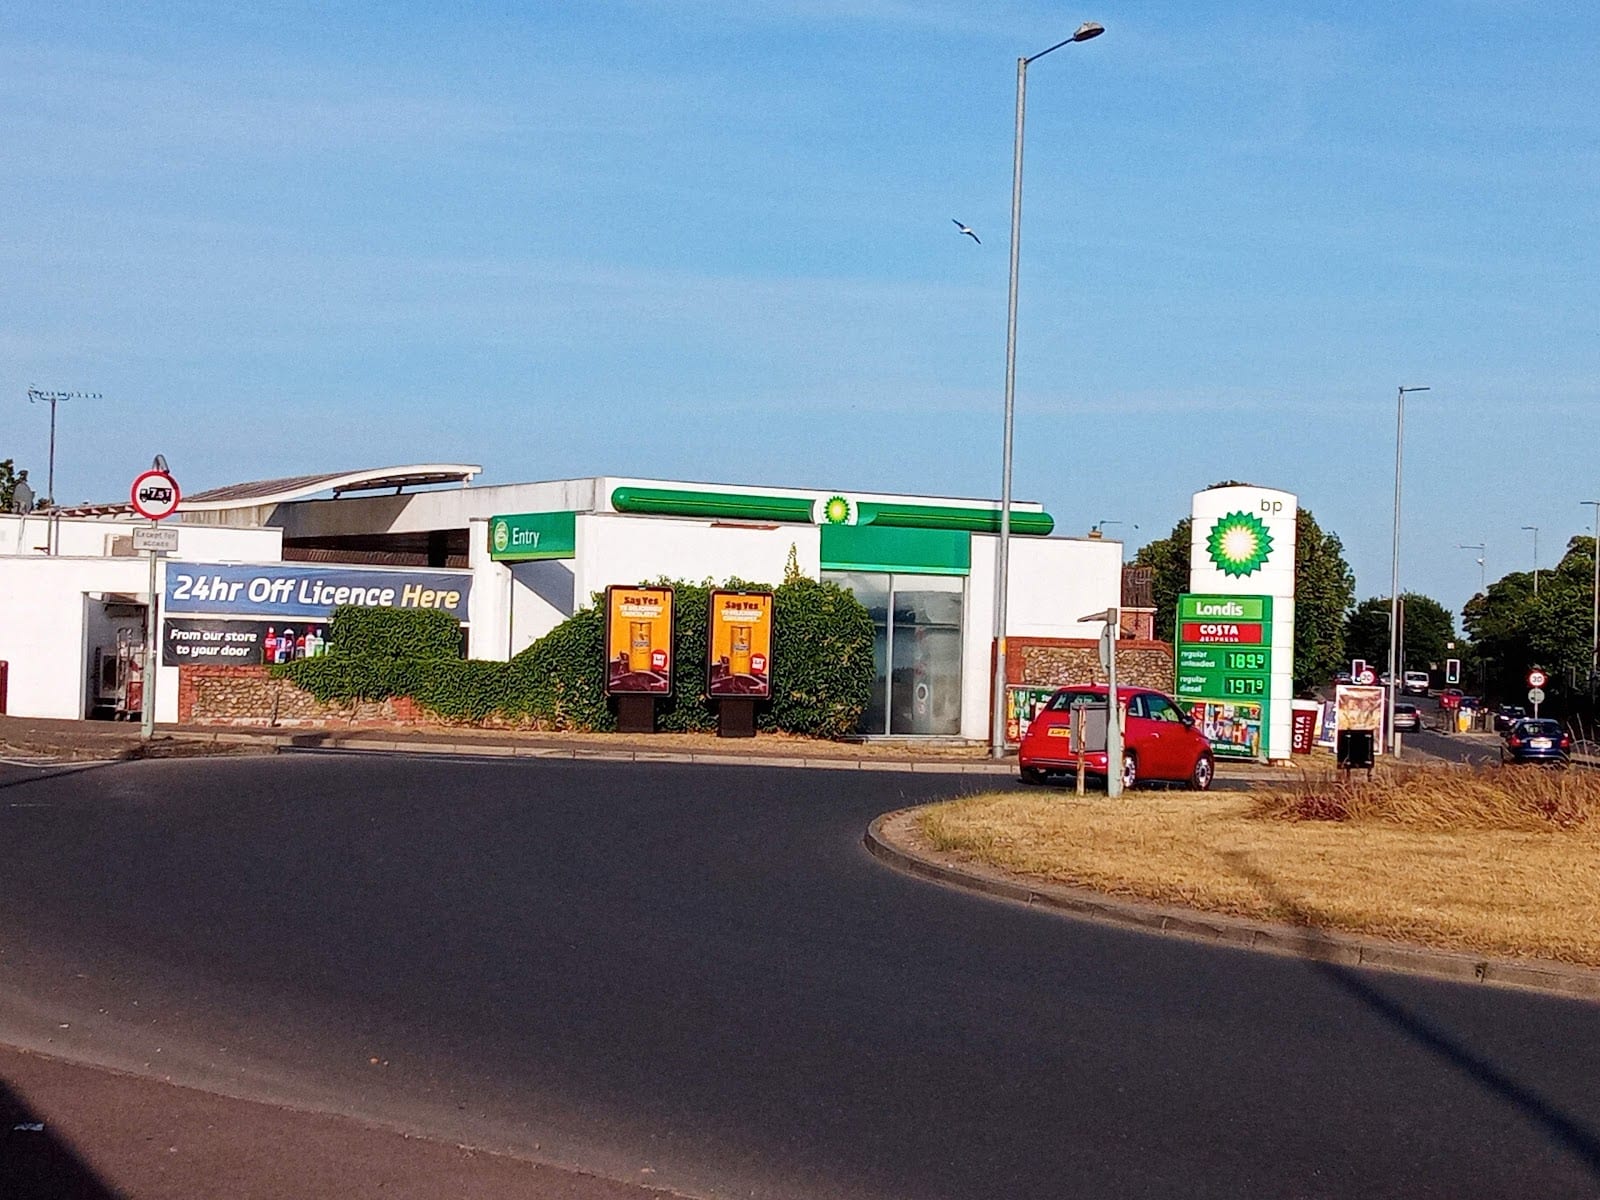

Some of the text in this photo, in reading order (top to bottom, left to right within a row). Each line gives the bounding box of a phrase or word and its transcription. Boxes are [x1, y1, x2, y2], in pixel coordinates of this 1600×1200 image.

[1261, 498, 1283, 515] bp
[512, 527, 540, 548] Entry
[173, 575, 461, 609] 24hr Off Licence Here
[624, 597, 659, 605] Say Yes
[725, 601, 759, 610] Say Yes
[1196, 602, 1244, 616] Londis
[170, 629, 257, 642] From our store
[1200, 625, 1238, 635] COSTA
[176, 645, 250, 657] to your door
[1181, 651, 1207, 659] regular
[1181, 660, 1216, 668] unleaded
[1180, 676, 1207, 684] regular
[1293, 716, 1305, 749] COSTA
